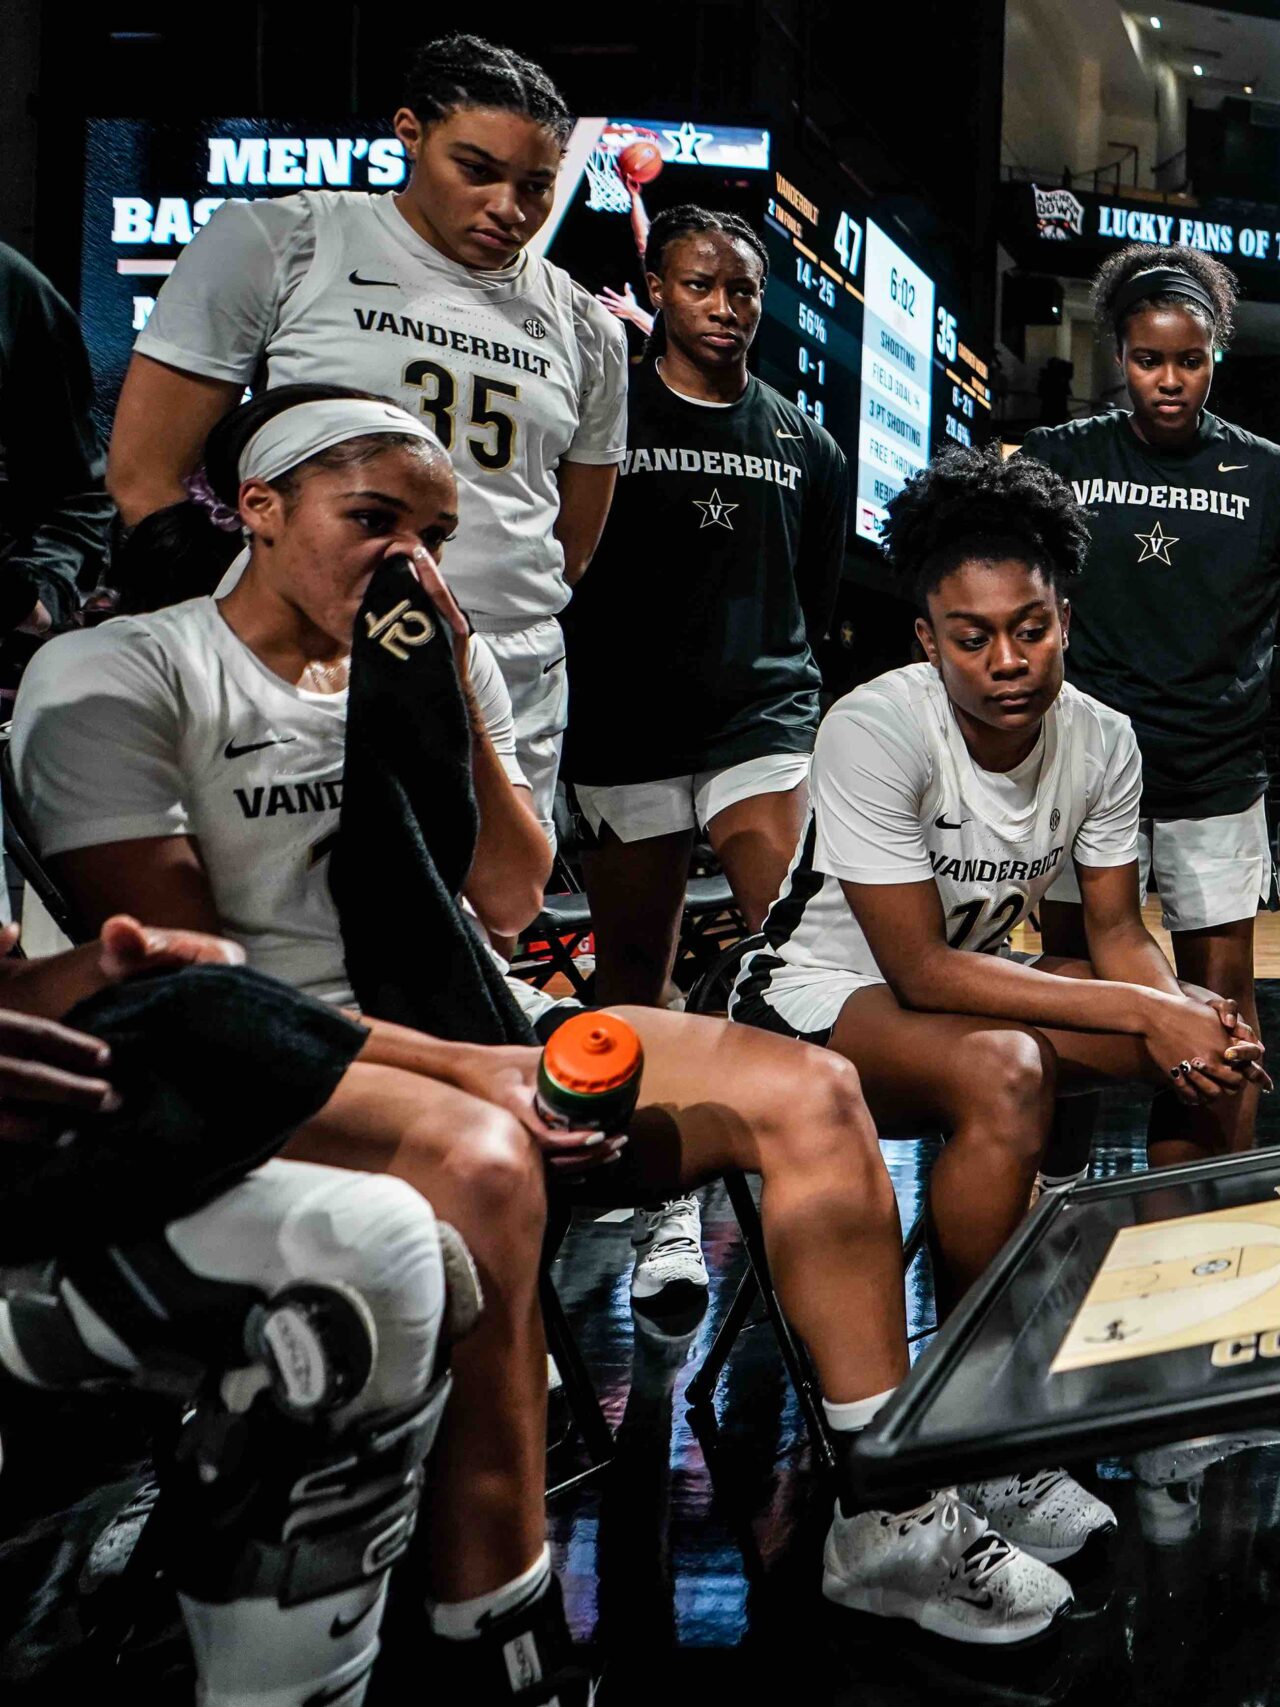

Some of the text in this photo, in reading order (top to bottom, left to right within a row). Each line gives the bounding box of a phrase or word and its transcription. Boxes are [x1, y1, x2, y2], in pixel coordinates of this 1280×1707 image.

[207, 137, 407, 185] MEN'S
[111, 197, 228, 244] BAS
[768, 198, 776, 217] 2
[776, 171, 820, 227] VANDERBILT
[834, 211, 863, 277] 47
[1099, 206, 1174, 246] LUCKY
[1179, 219, 1233, 254] FANS
[1239, 228, 1270, 259] OF
[797, 257, 836, 309] 14-25
[890, 267, 916, 318] 6:02
[353, 308, 551, 379] VANDERBILT
[799, 302, 827, 344] 56%
[937, 306, 957, 362] 35
[799, 347, 825, 385] 0-1
[880, 331, 916, 372] SHOOTING
[873, 363, 893, 392] FIELD
[402, 358, 521, 473] 35
[869, 399, 921, 447] 3 PT SHOOTING
[617, 448, 802, 491] VANDERBILT
[870, 439, 889, 465] FREE
[1071, 478, 1250, 521] VANDERBILT
[929, 846, 1063, 883] VANDERBILT
[947, 892, 1028, 952] 12
